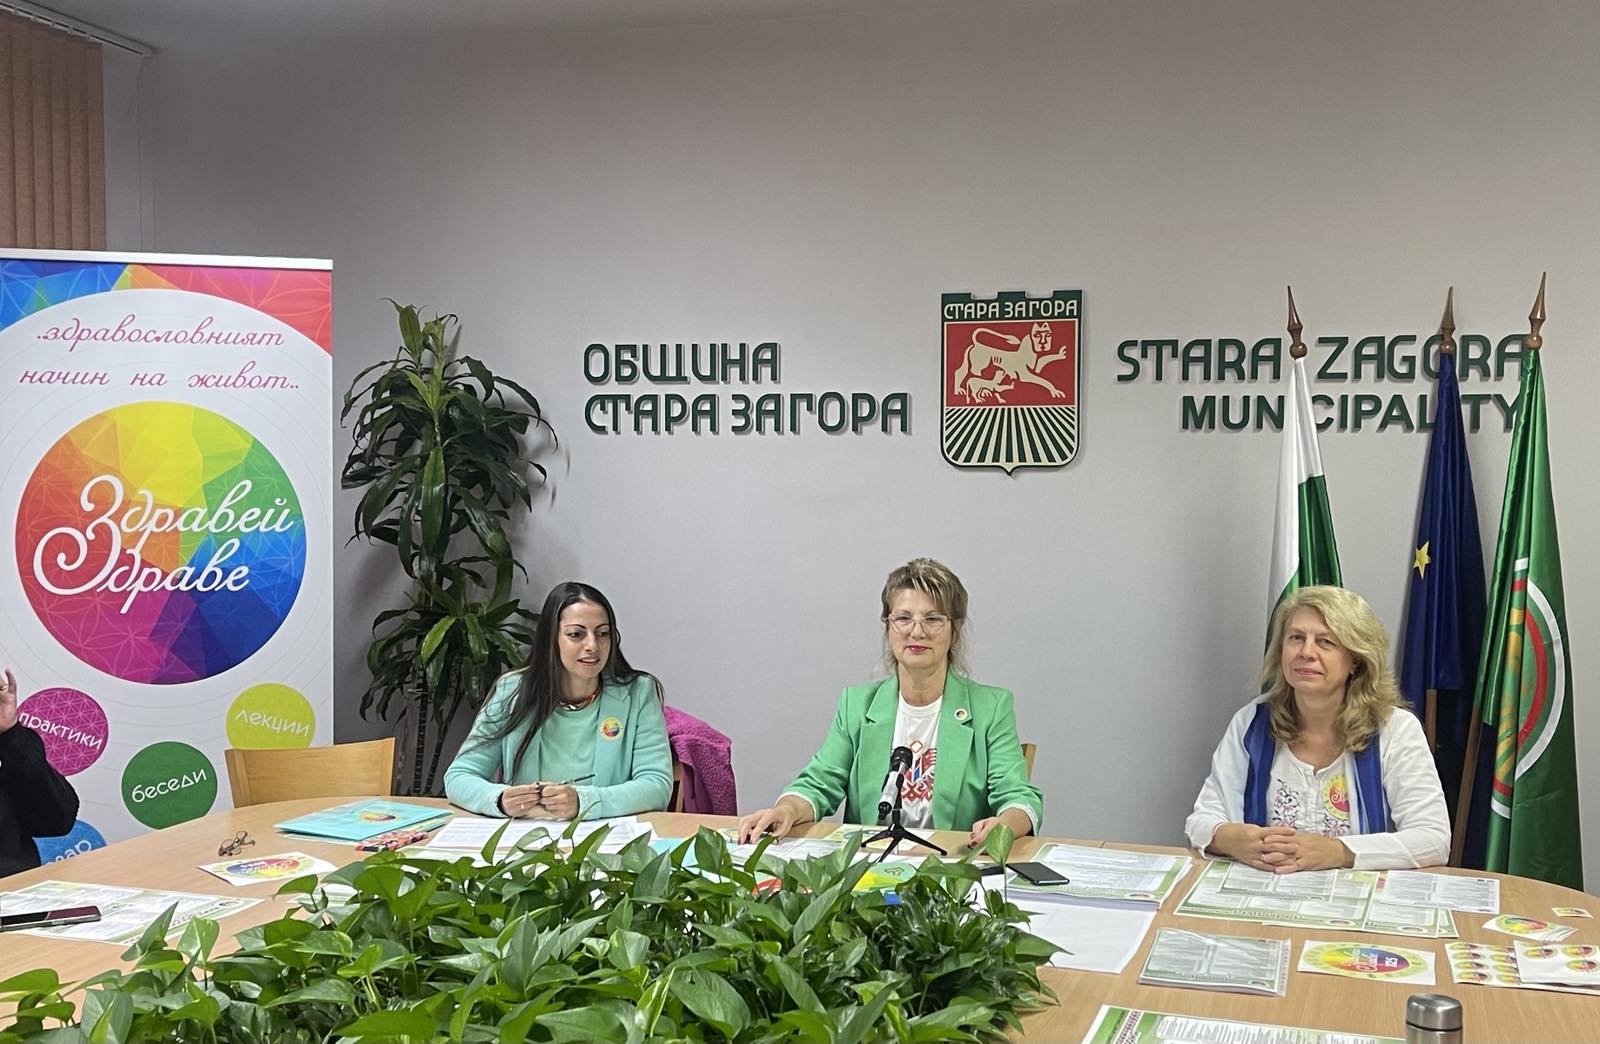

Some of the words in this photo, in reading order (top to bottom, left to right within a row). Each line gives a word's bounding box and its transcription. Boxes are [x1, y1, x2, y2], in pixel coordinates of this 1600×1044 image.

[944, 302, 999, 319] СТАРА
[1004, 300, 1077, 317] ЗАГОРА
[19, 369, 110, 386] начин
[130, 371, 167, 387] на
[583, 342, 779, 383] ОБЩИНА
[1117, 337, 1283, 382] STARA
[584, 393, 719, 434] СТАРА
[731, 391, 909, 434] ЗАГОРА
[1181, 394, 1521, 432] MUNCIPALTY
[80, 475, 295, 541] Здравей
[33, 526, 250, 614] Здраве
[18, 712, 104, 750] практики
[235, 708, 310, 737] лекции
[131, 768, 208, 803] беседи
